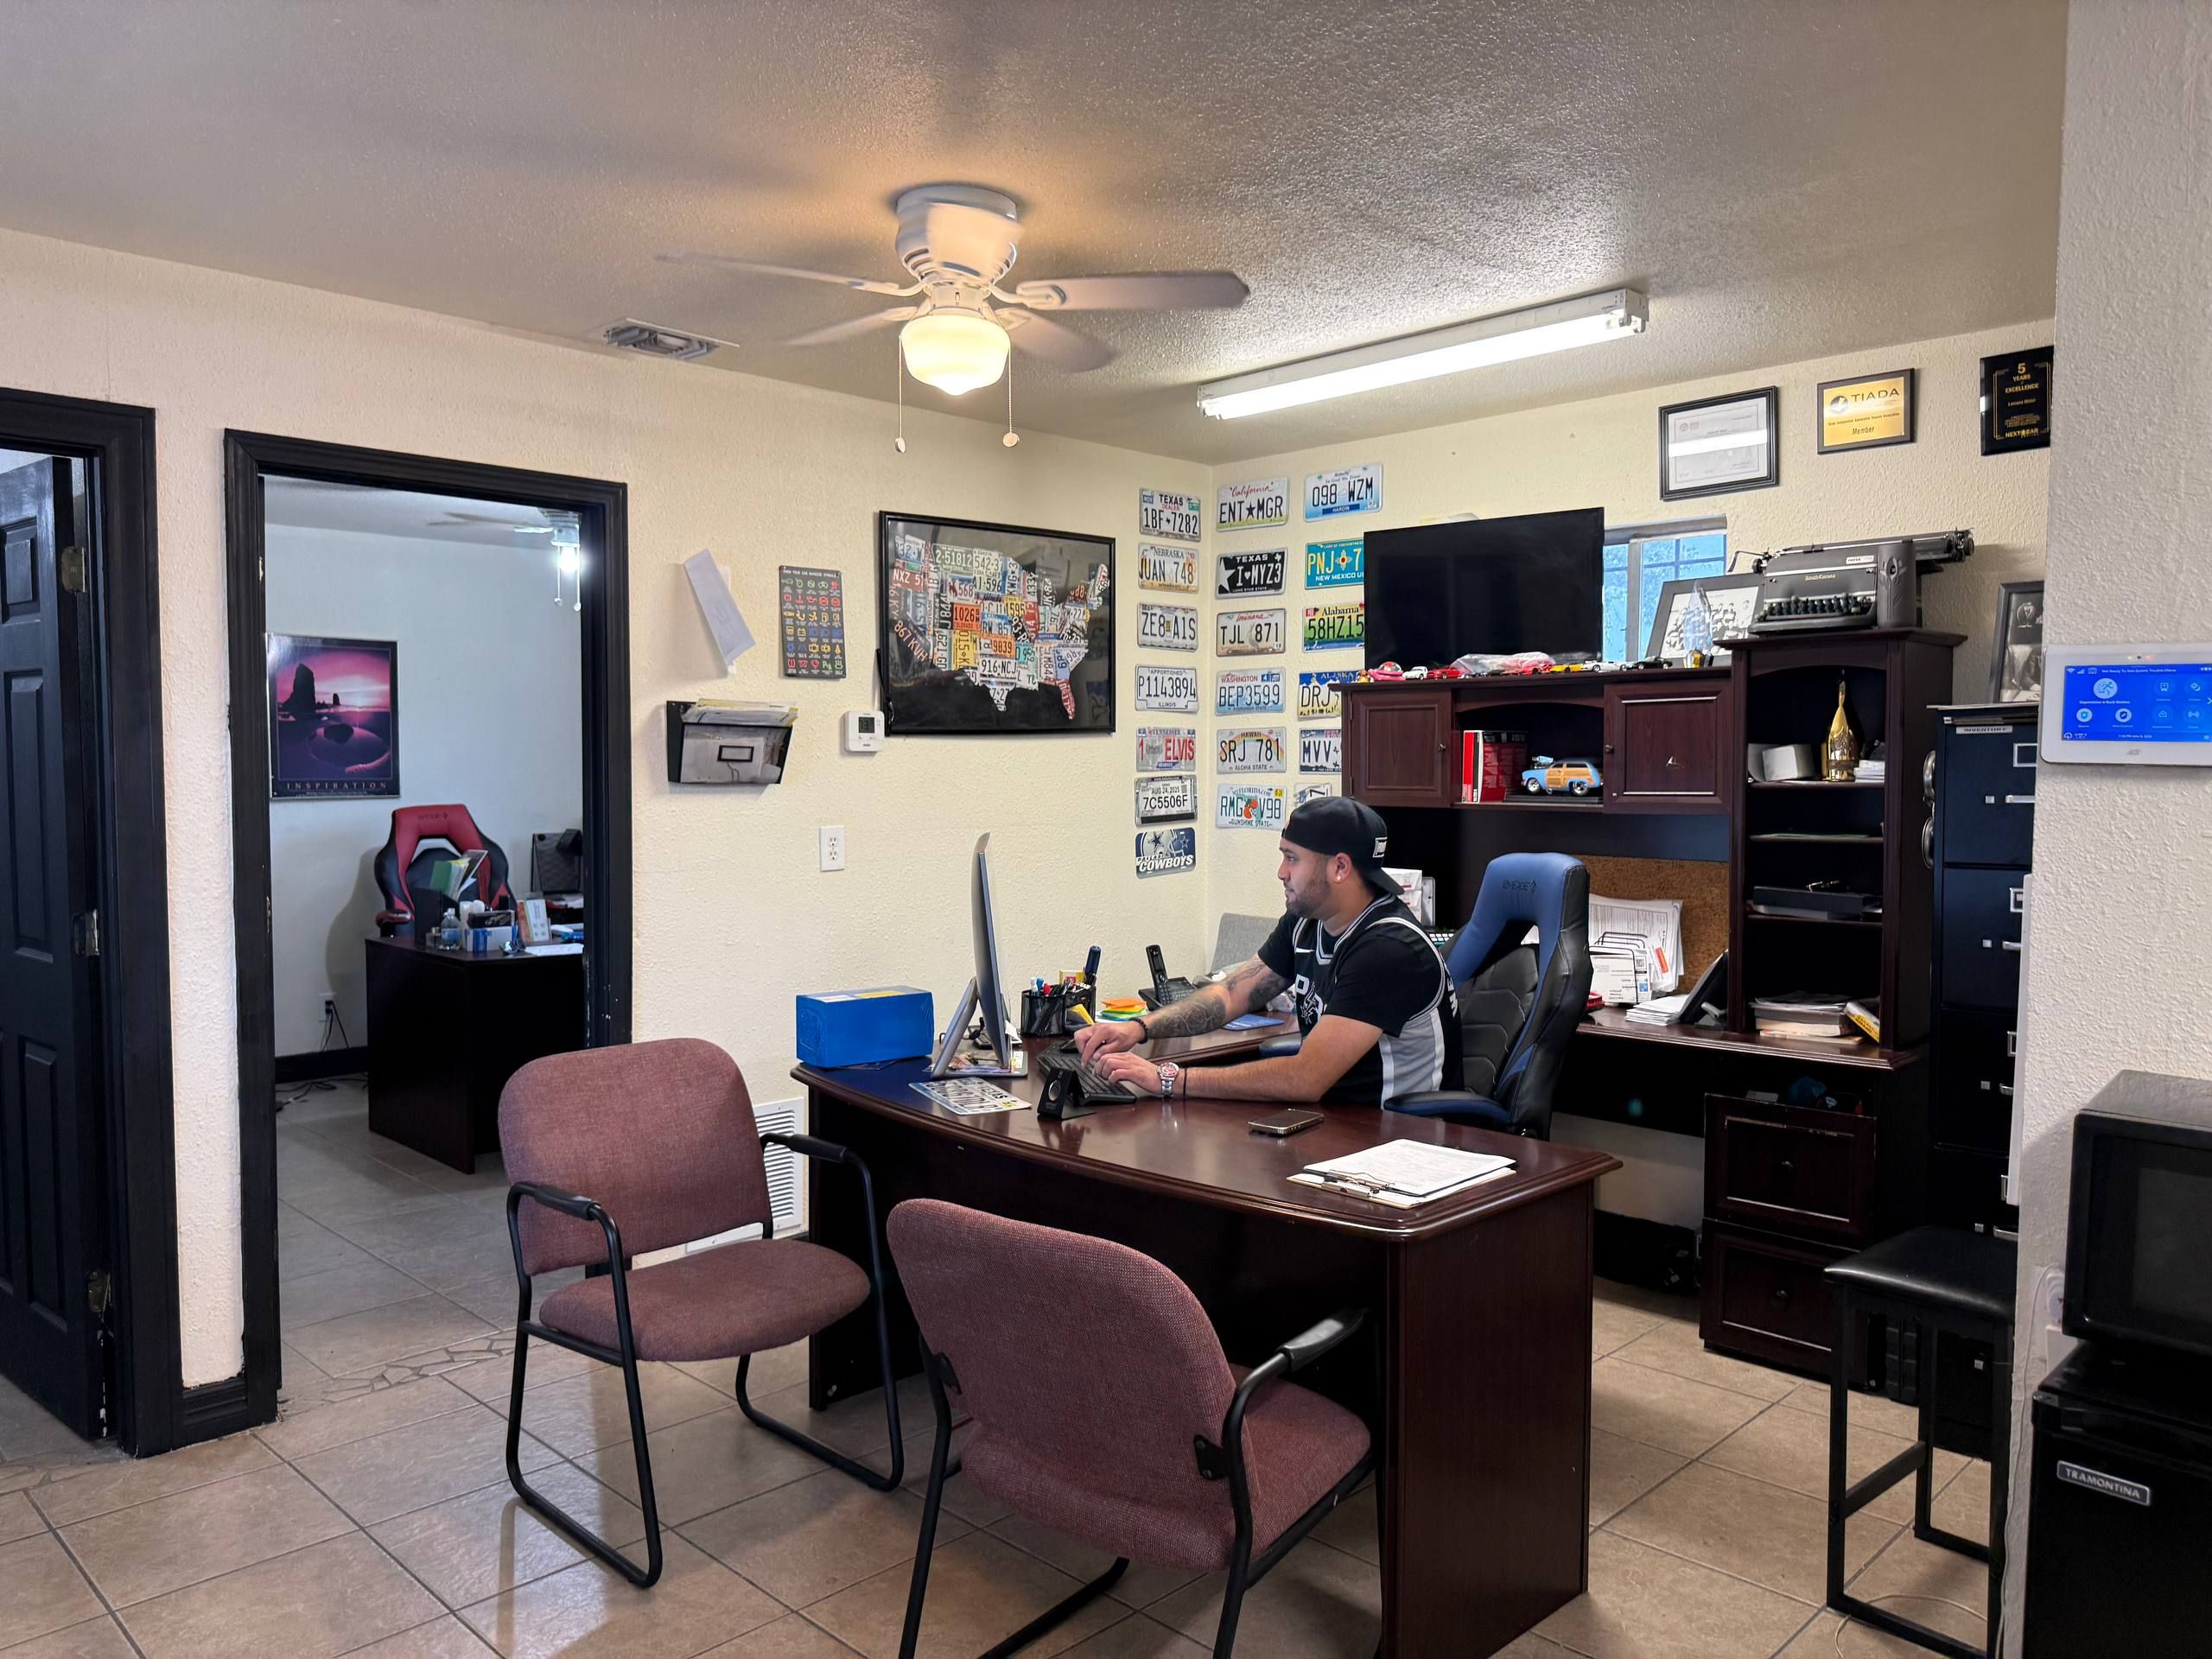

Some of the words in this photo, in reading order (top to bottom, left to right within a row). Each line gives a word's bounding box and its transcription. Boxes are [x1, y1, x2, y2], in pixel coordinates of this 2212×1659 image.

[2018, 363, 2025, 373] 5
[1851, 388, 1899, 402] TIADA
[2005, 383, 2038, 393] EXCELLENCE
[1852, 426, 1874, 435] Member
[1159, 494, 1183, 505] TEXAS
[1231, 484, 1271, 498] California
[1348, 477, 1373, 502] WZM
[1219, 501, 1244, 524] ENT
[1256, 496, 1282, 520] MGR
[1154, 549, 1184, 559] NEBRASKA
[1236, 554, 1268, 563] TEXAS
[1307, 550, 1334, 575] PNJ
[1173, 562, 1193, 584] 748
[954, 607, 975, 622] 1026
[1321, 607, 1359, 616] Alabama
[1141, 612, 1166, 637] ZE8
[1220, 625, 1244, 645] TJL
[1255, 622, 1279, 643] 871
[894, 620, 912, 641] 867
[907, 638, 928, 662] KVH
[1138, 676, 1196, 698] P1143894
[1221, 675, 1258, 683] WASHINGTON
[1219, 684, 1280, 707] BEP3599
[1165, 738, 1194, 760] ELVIS
[1219, 740, 1245, 763] SRJ
[1255, 738, 1279, 762] 781
[1302, 741, 1332, 763] MVV
[1143, 795, 1188, 810] 7C5506F
[1220, 796, 1243, 817] RMG
[1259, 798, 1281, 819] V98
[1139, 855, 1193, 872] COWBOYS
[2064, 1468, 2140, 1499] TRAMONTINA
